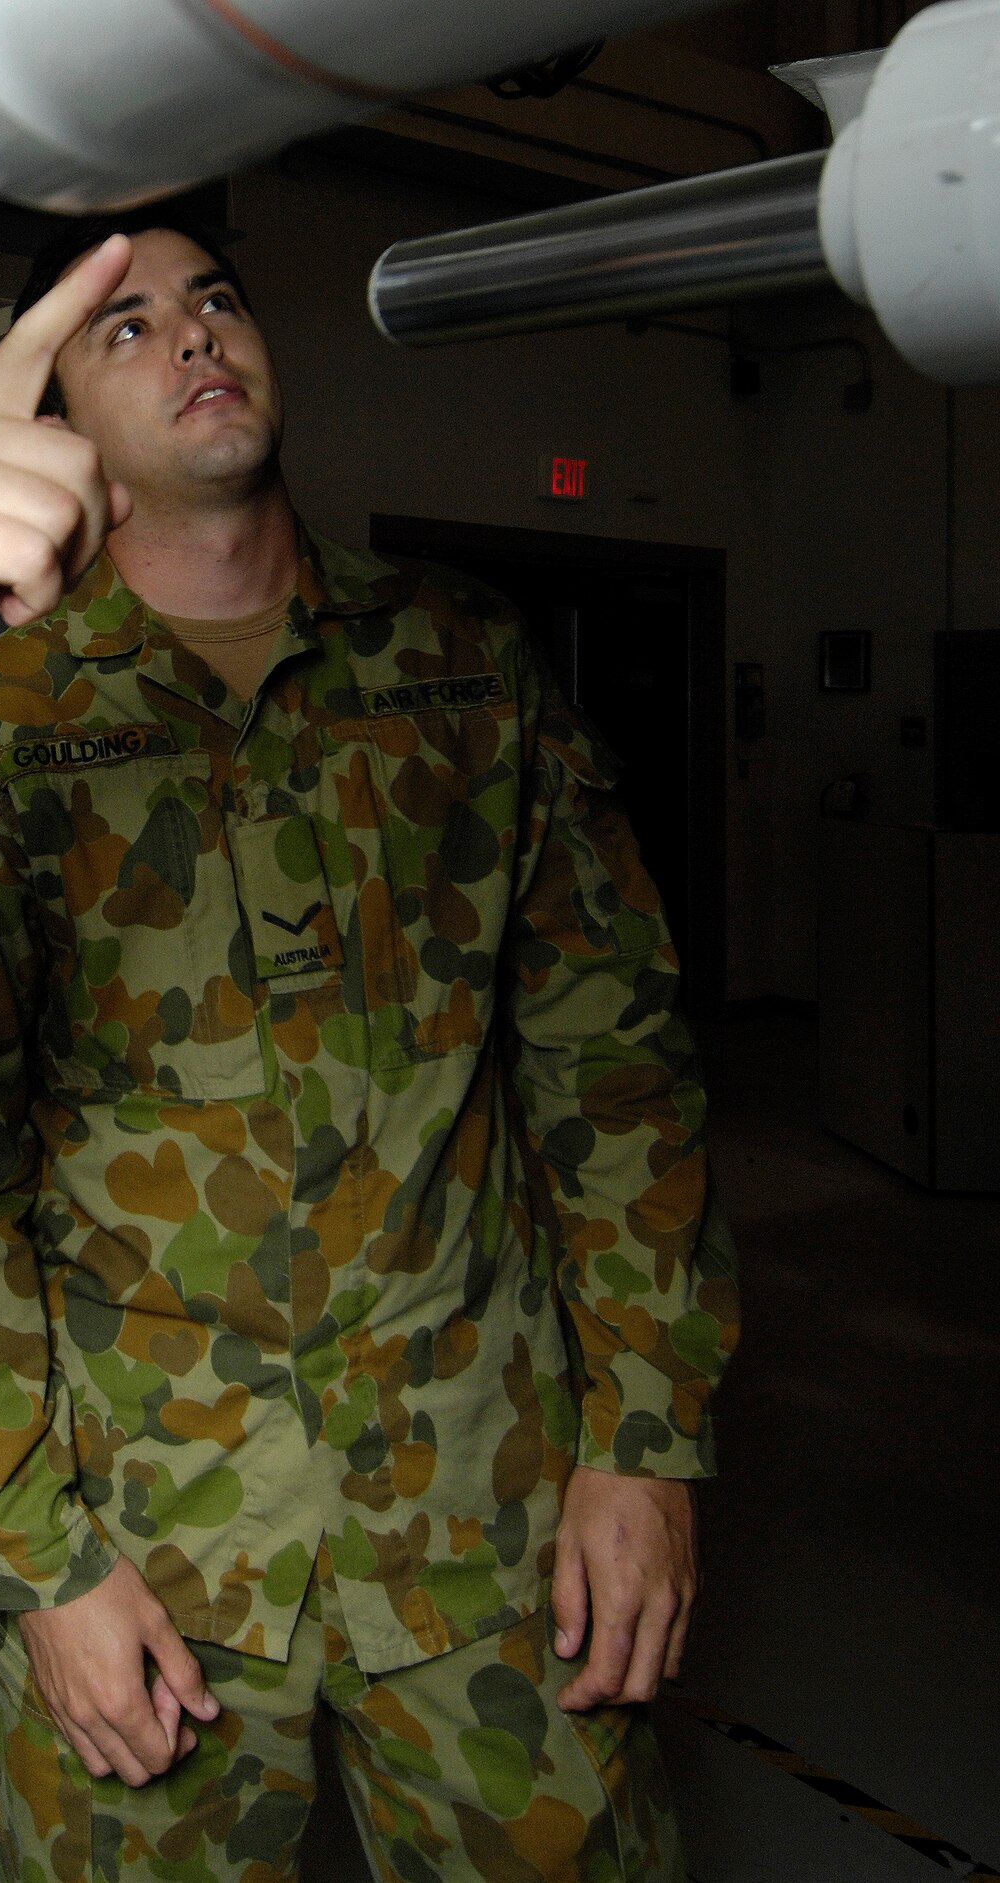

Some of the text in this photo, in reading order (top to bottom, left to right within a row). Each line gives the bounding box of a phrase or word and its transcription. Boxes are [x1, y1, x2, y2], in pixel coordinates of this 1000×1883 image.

[552, 457, 586, 497] EXIT
[374, 679, 503, 713] AIR FORCE
[13, 731, 142, 767] GOULDING
[274, 944, 332, 967] AUSTRALIA
